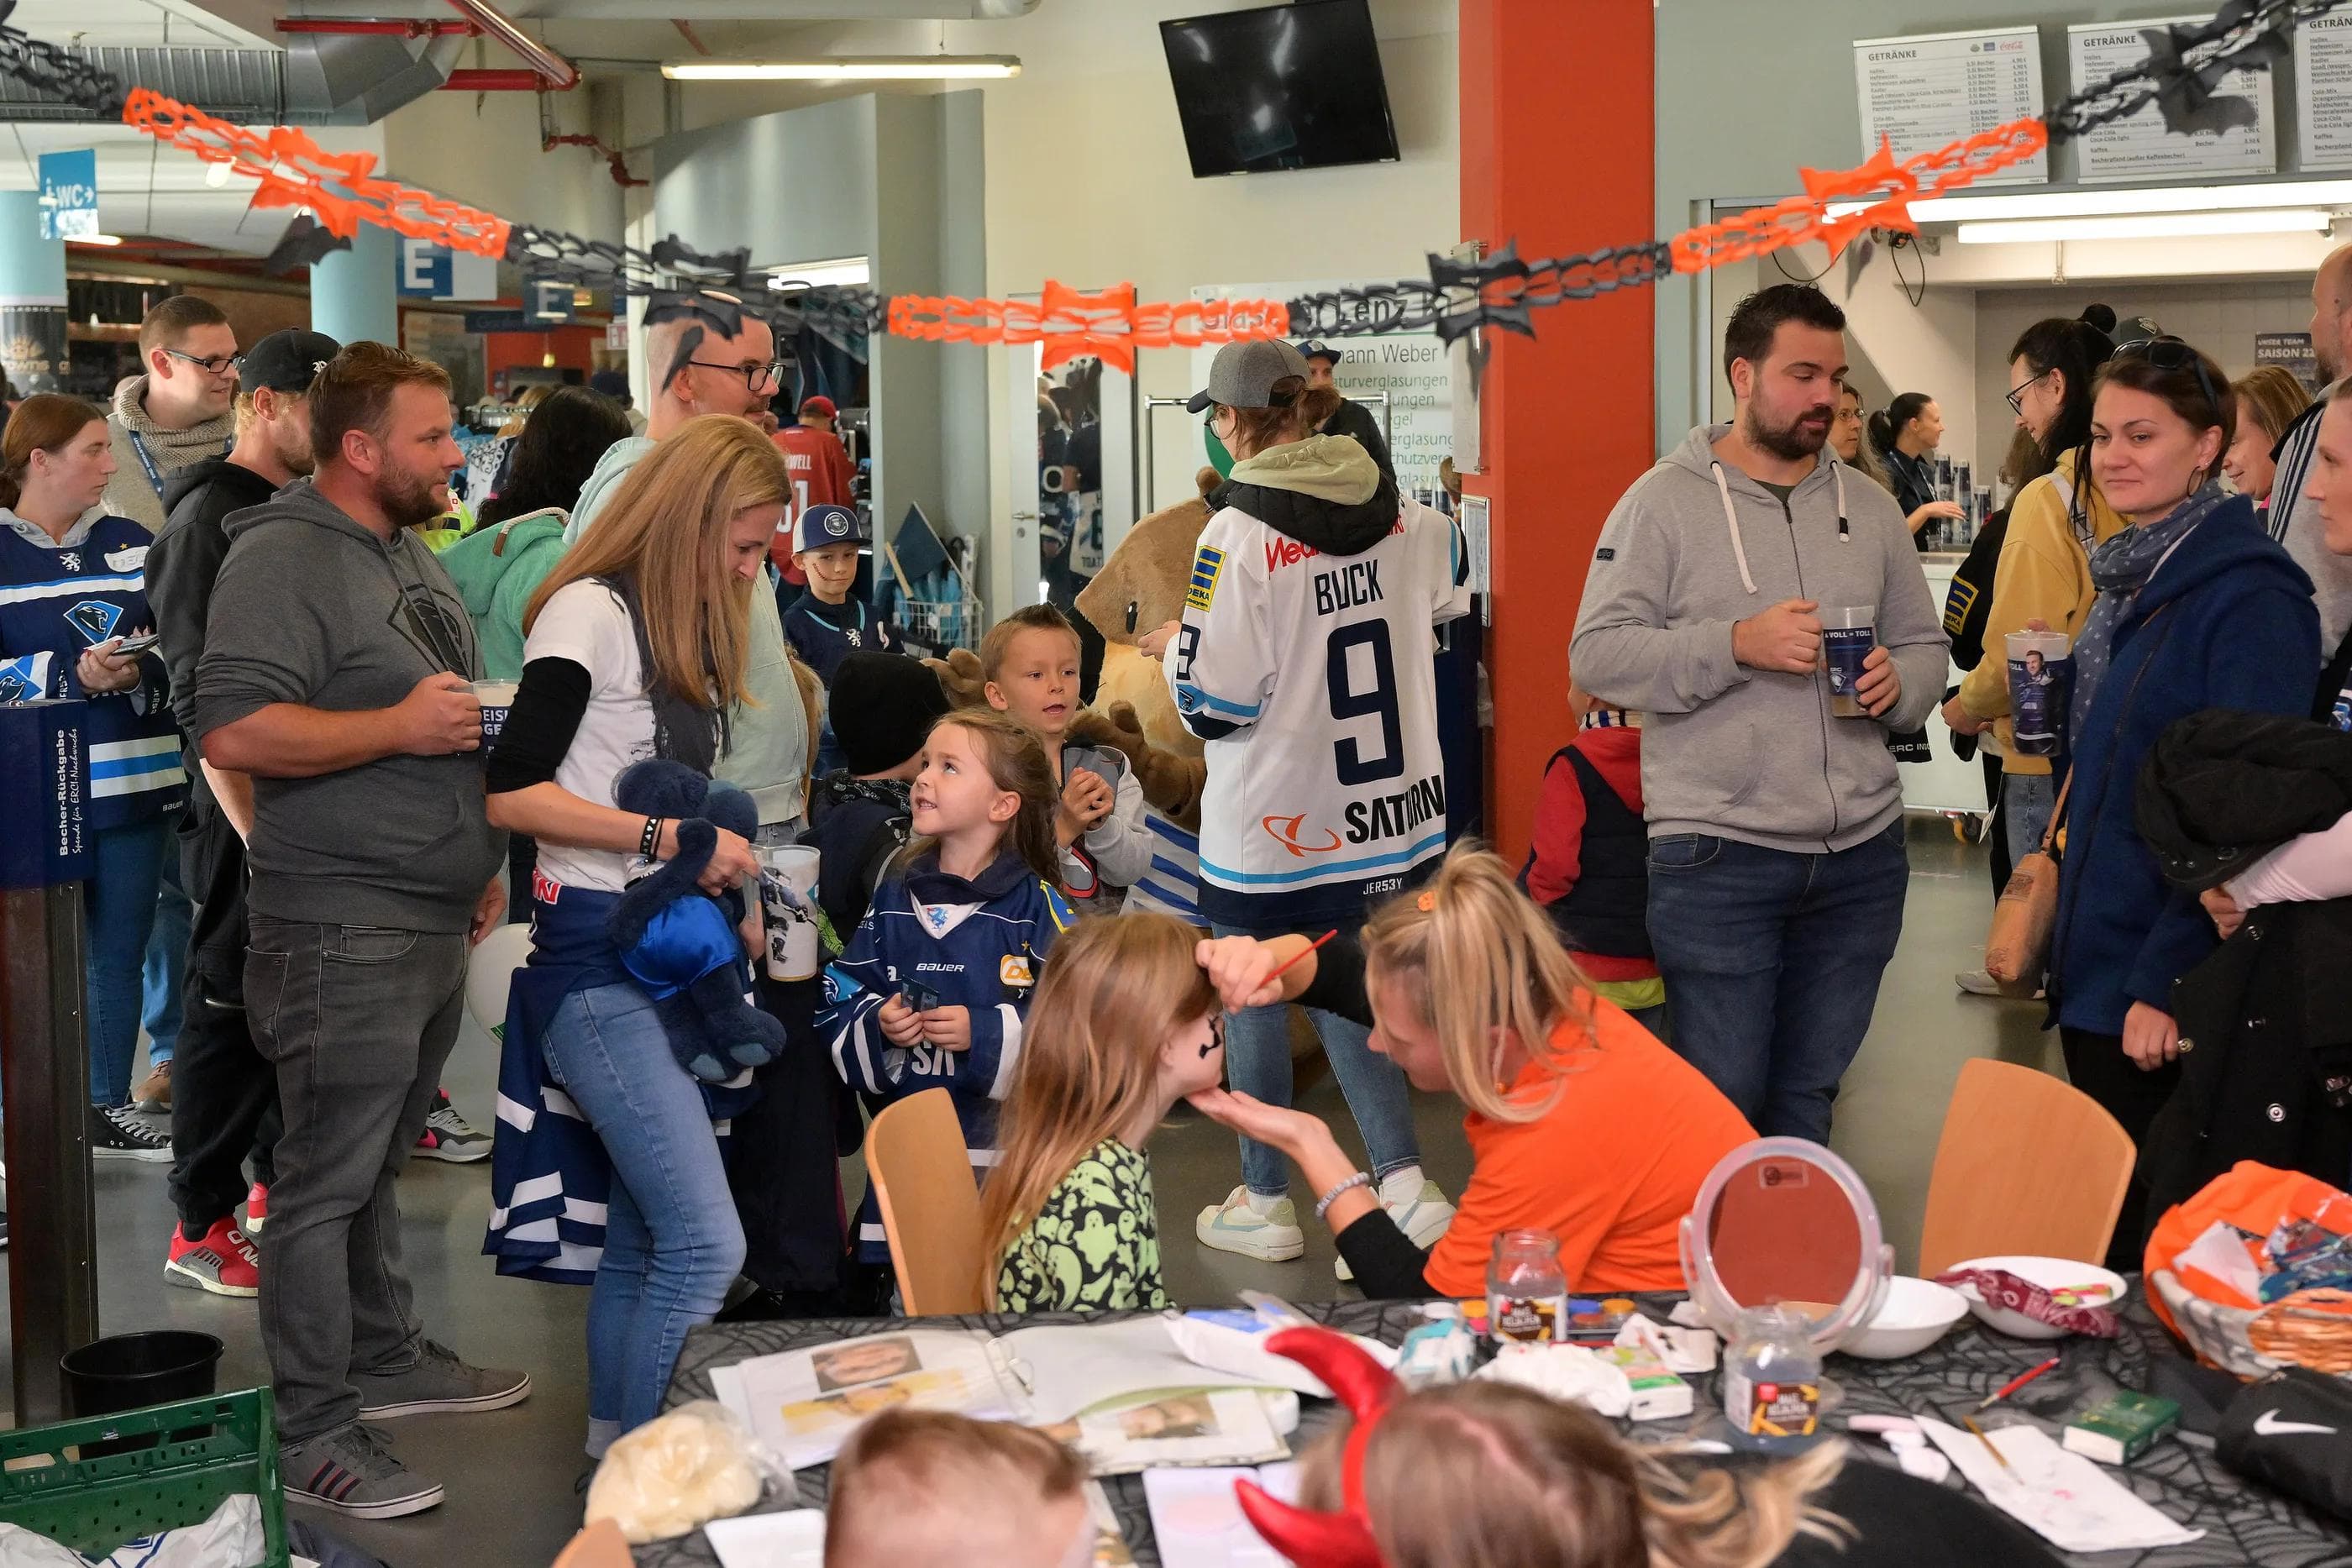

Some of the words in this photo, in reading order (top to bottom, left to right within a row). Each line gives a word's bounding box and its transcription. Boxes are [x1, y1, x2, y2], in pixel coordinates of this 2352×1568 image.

[2083, 35, 2136, 47] GETRÄNKE
[1868, 50, 1918, 61] GETRÄNKE
[56, 183, 83, 208] WC
[403, 239, 434, 289] E
[1382, 343, 1439, 363] Weber
[2257, 347, 2300, 359] SAISON
[1313, 559, 1384, 616] BUCK
[1829, 631, 1848, 639] VOLL
[1326, 618, 1405, 787] 9
[1888, 743, 1914, 753] ERC
[55, 729, 69, 857] Becher-Rückgabe
[1344, 774, 1446, 845] SATURN
[71, 823, 84, 854] Spende
[1362, 877, 1404, 895] JER53Y
[916, 962, 965, 973] BAUER
